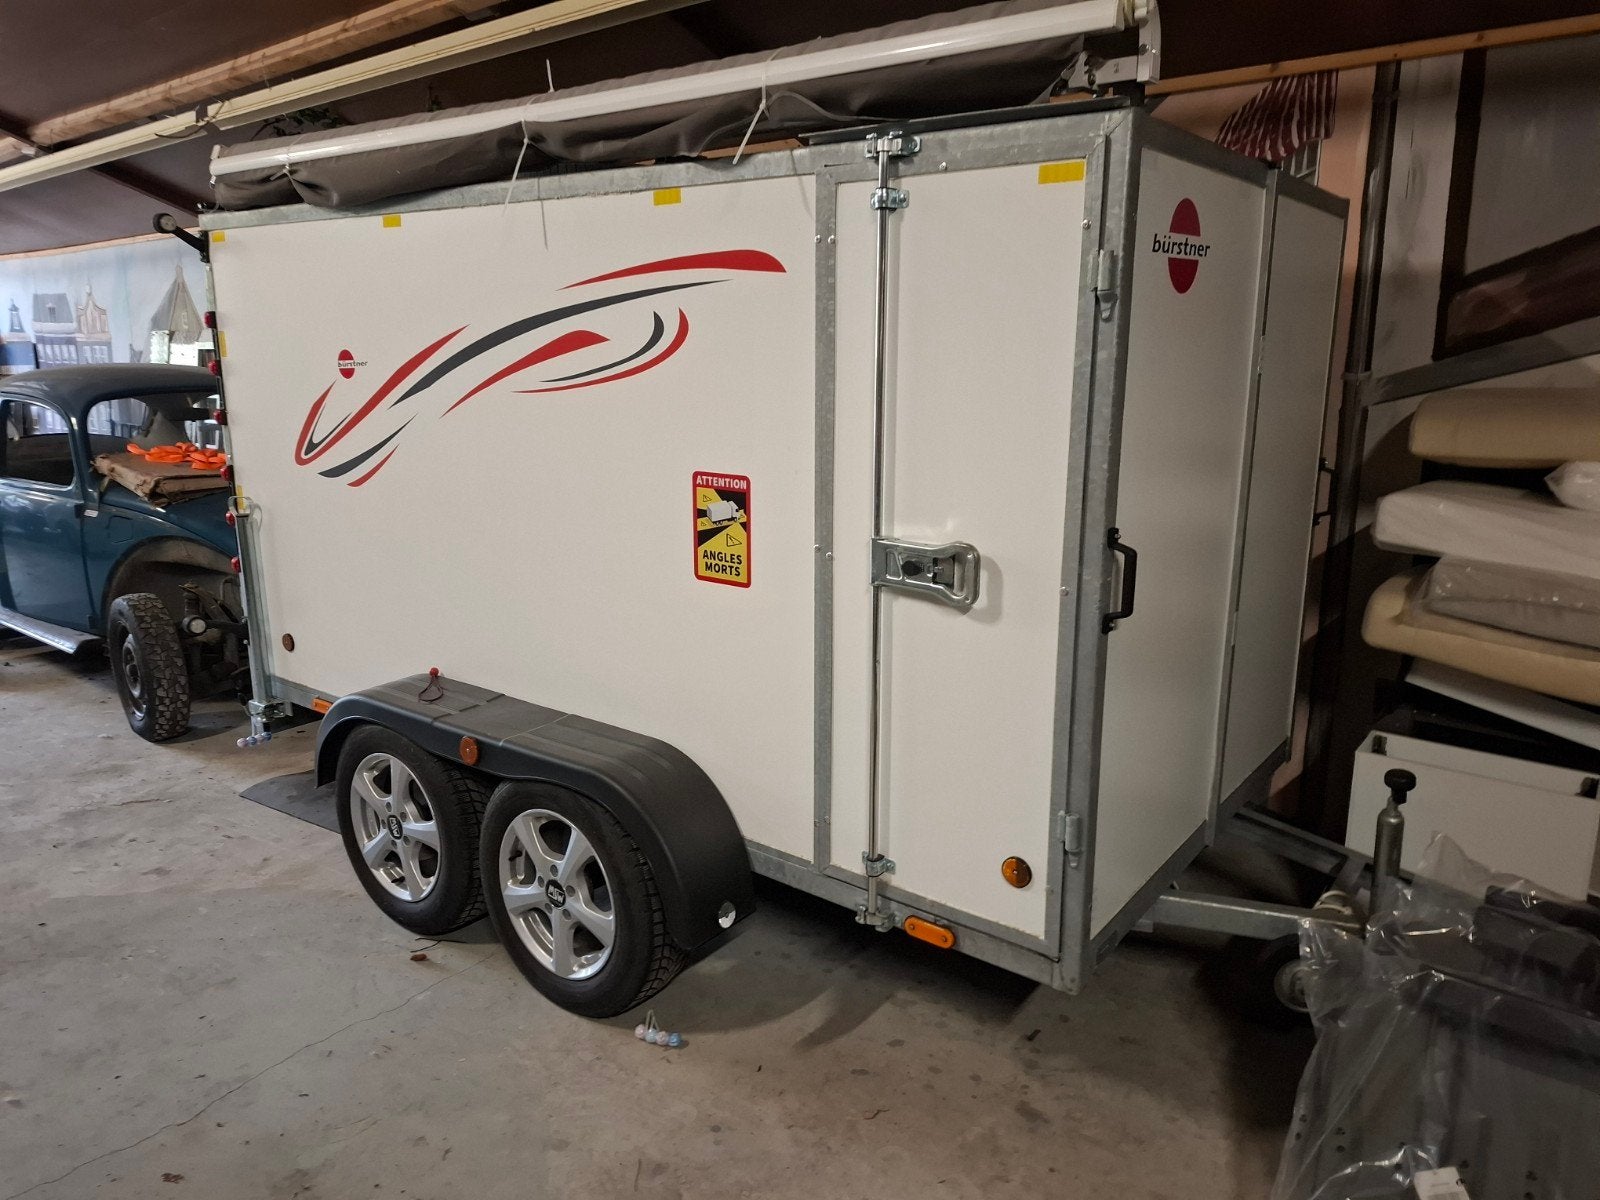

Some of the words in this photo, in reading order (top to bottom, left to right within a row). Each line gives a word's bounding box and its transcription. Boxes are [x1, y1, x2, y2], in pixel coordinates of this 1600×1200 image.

[1152, 233, 1211, 257] bürstner
[696, 475, 747, 491] ATTENTION
[702, 549, 742, 566] ANGLES
[704, 561, 741, 577] MORTS
[547, 884, 566, 904] MSW
